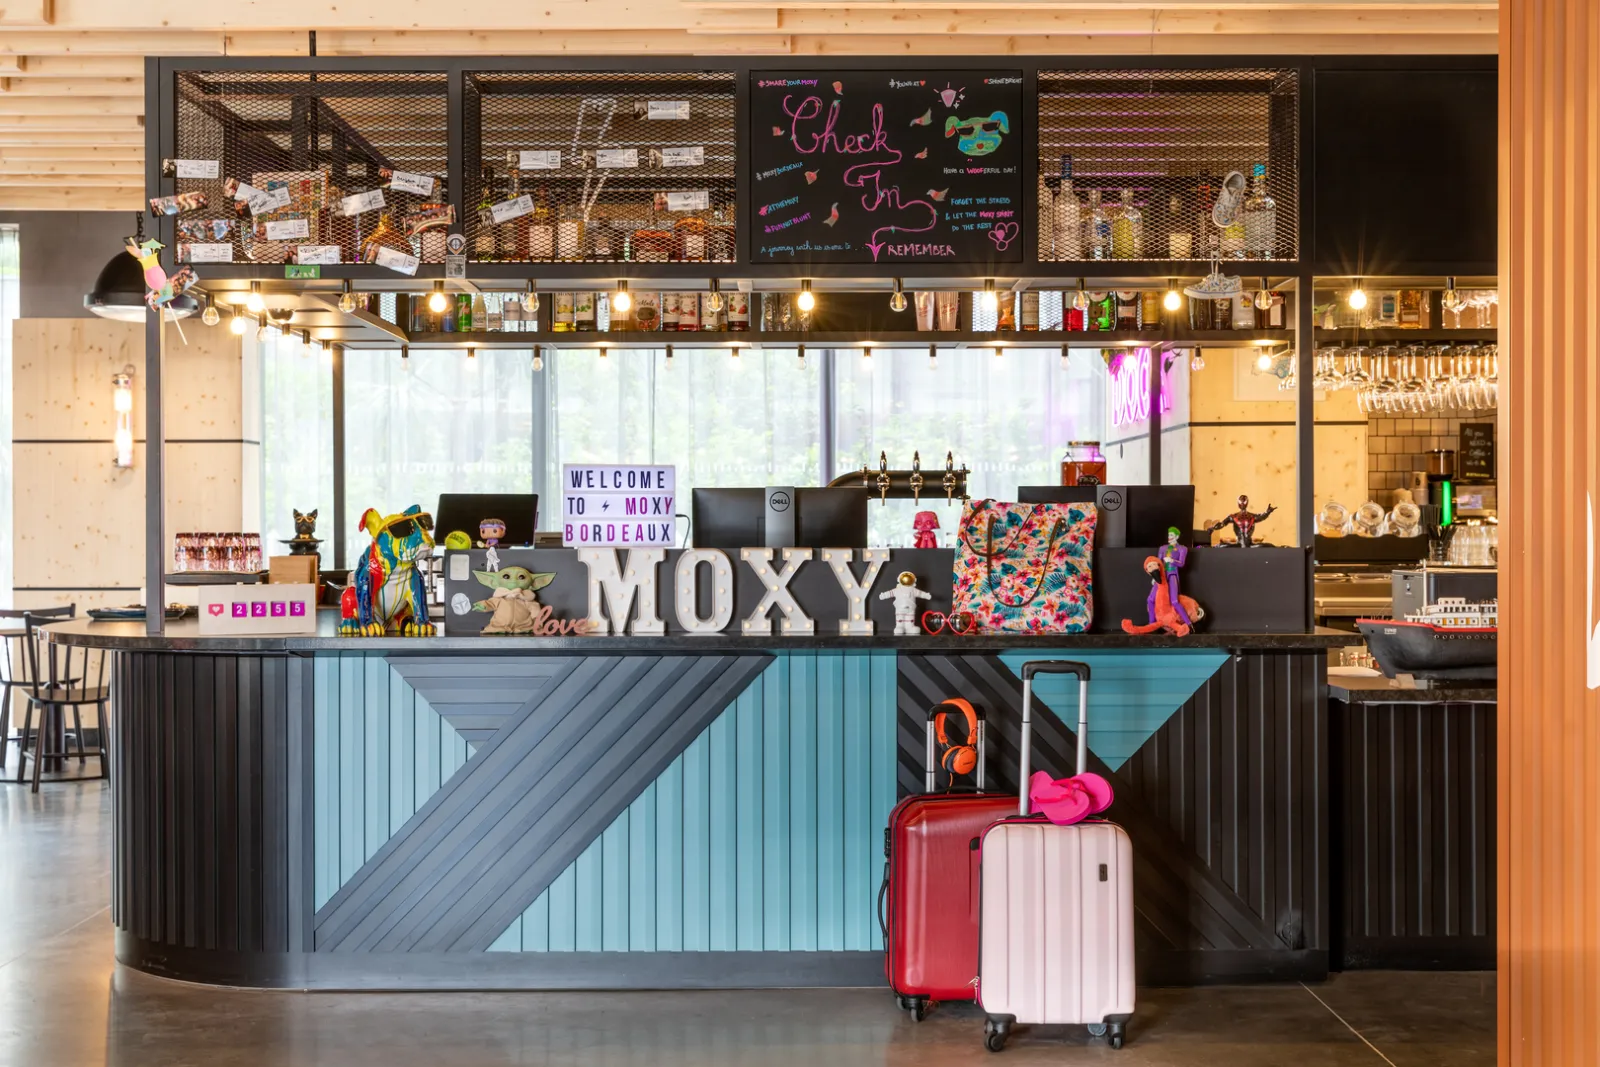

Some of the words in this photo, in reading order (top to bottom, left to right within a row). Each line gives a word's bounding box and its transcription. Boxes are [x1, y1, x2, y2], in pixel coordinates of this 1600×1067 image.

[782, 95, 892, 154] Check
[857, 169, 903, 212] In
[951, 197, 974, 206] FORGET
[952, 212, 965, 220] LET
[965, 211, 978, 219] THE
[962, 223, 975, 231] THE
[976, 222, 993, 230] REST
[887, 242, 956, 256] REMEMBER
[571, 470, 665, 489] WELCOME
[567, 497, 586, 515] TO
[625, 496, 673, 515] MOXY
[565, 523, 671, 542] BORDEAUX
[577, 547, 891, 634] MOXY
[532, 605, 589, 636] love
